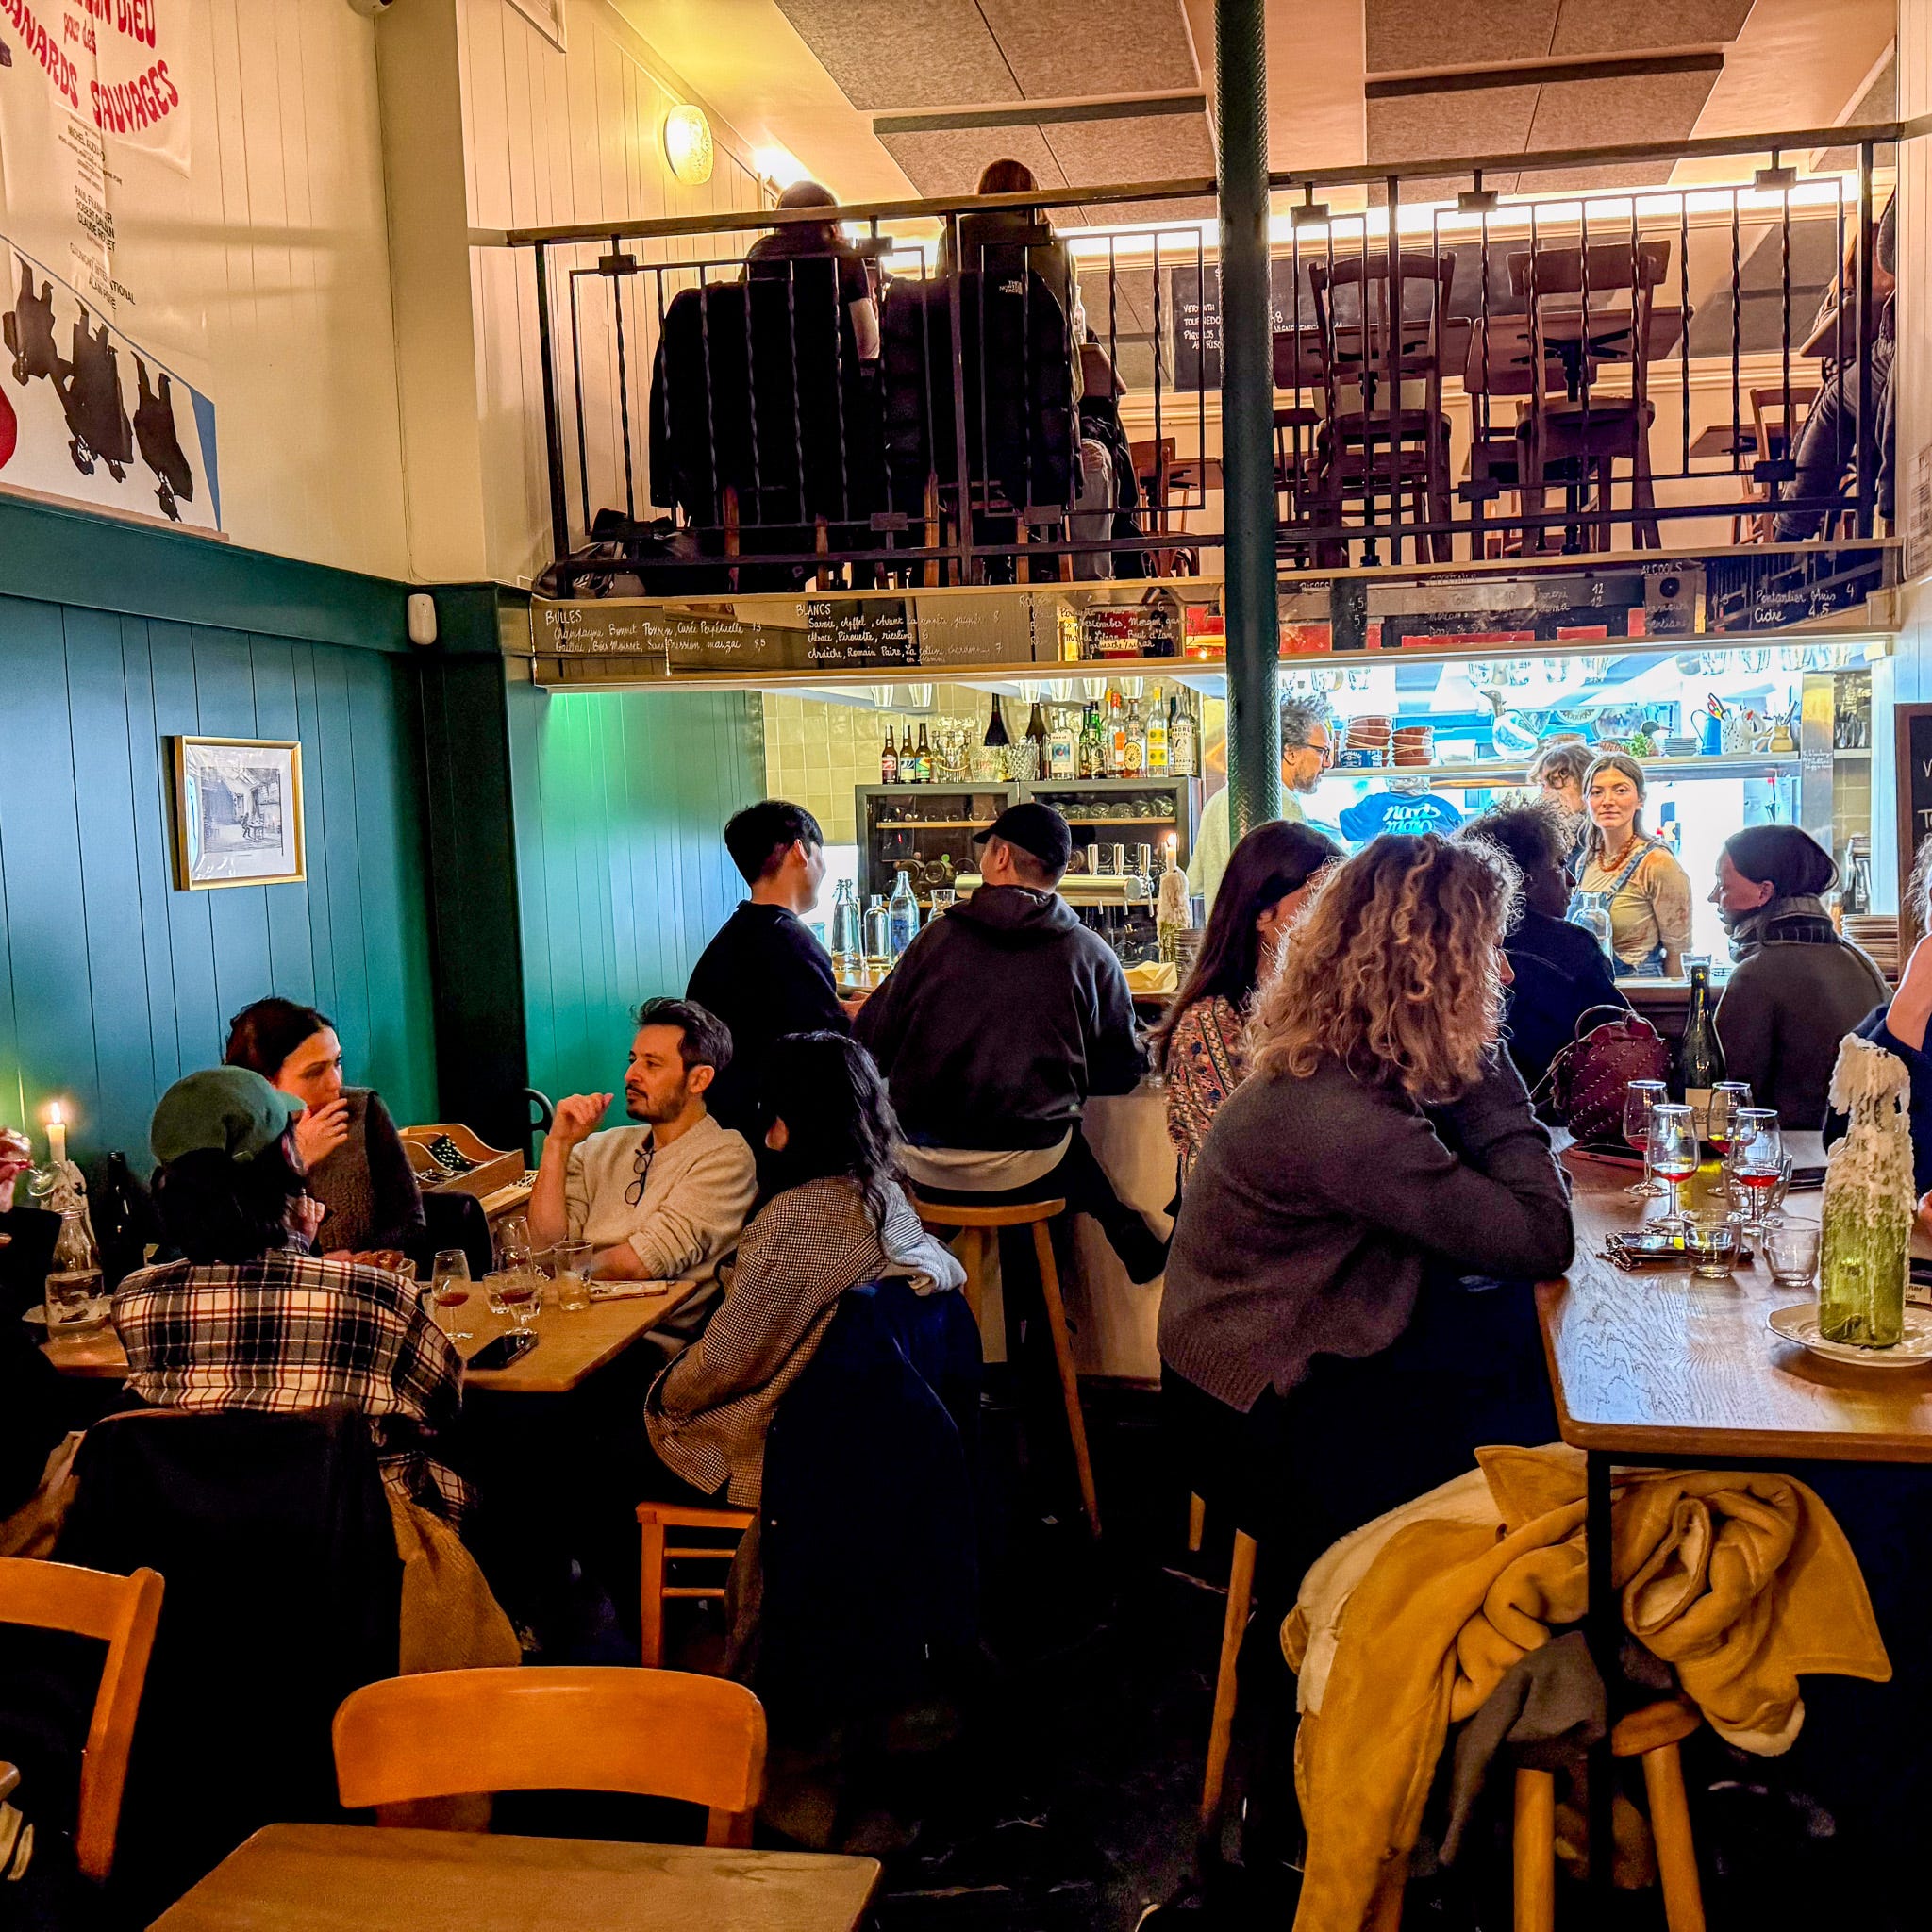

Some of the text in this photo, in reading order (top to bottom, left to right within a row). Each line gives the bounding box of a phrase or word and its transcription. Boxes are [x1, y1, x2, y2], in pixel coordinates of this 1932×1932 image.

[0, 0, 178, 133] ANARDS SAUVAGES
[1591, 582, 1605, 595] 12
[1846, 583, 1855, 597] 4
[1591, 596, 1604, 608] 12
[545, 608, 582, 625] BULLES
[796, 603, 831, 617] BLANCS
[1754, 607, 1786, 623] Cidre
